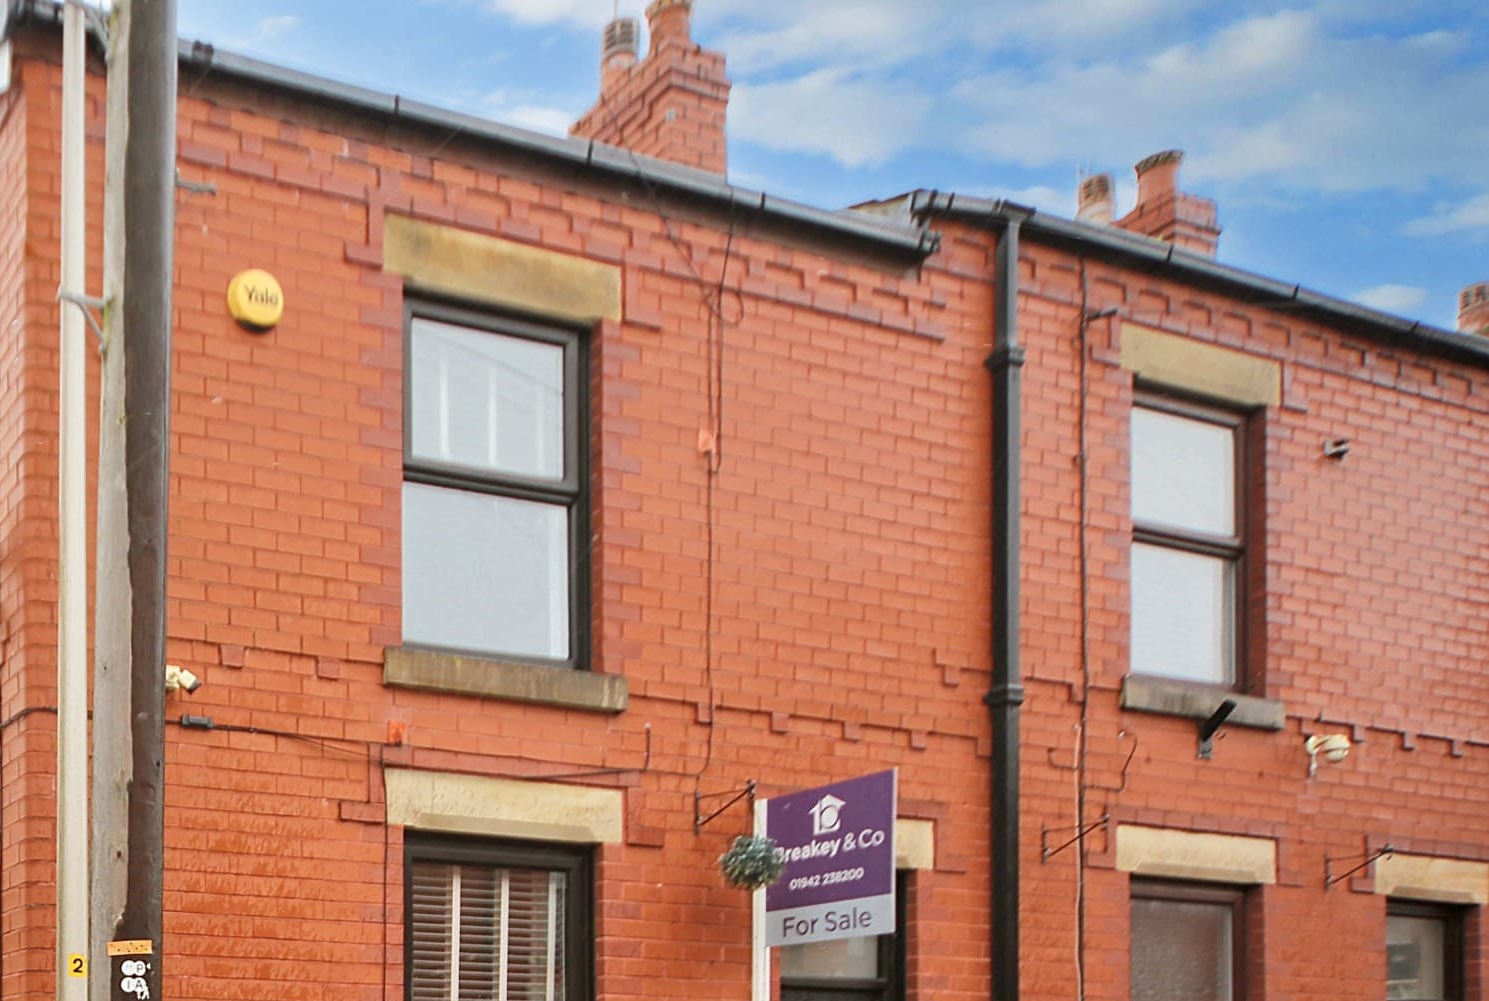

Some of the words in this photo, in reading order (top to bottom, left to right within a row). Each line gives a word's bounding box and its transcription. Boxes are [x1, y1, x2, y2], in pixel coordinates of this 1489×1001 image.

[244, 283, 278, 306] Yale
[772, 838, 841, 864] Breakey
[843, 832, 857, 852] &
[858, 828, 885, 849] Co
[789, 874, 821, 890] 01942
[782, 916, 819, 938] For
[825, 907, 872, 932] Sale
[72, 958, 84, 973] 2
